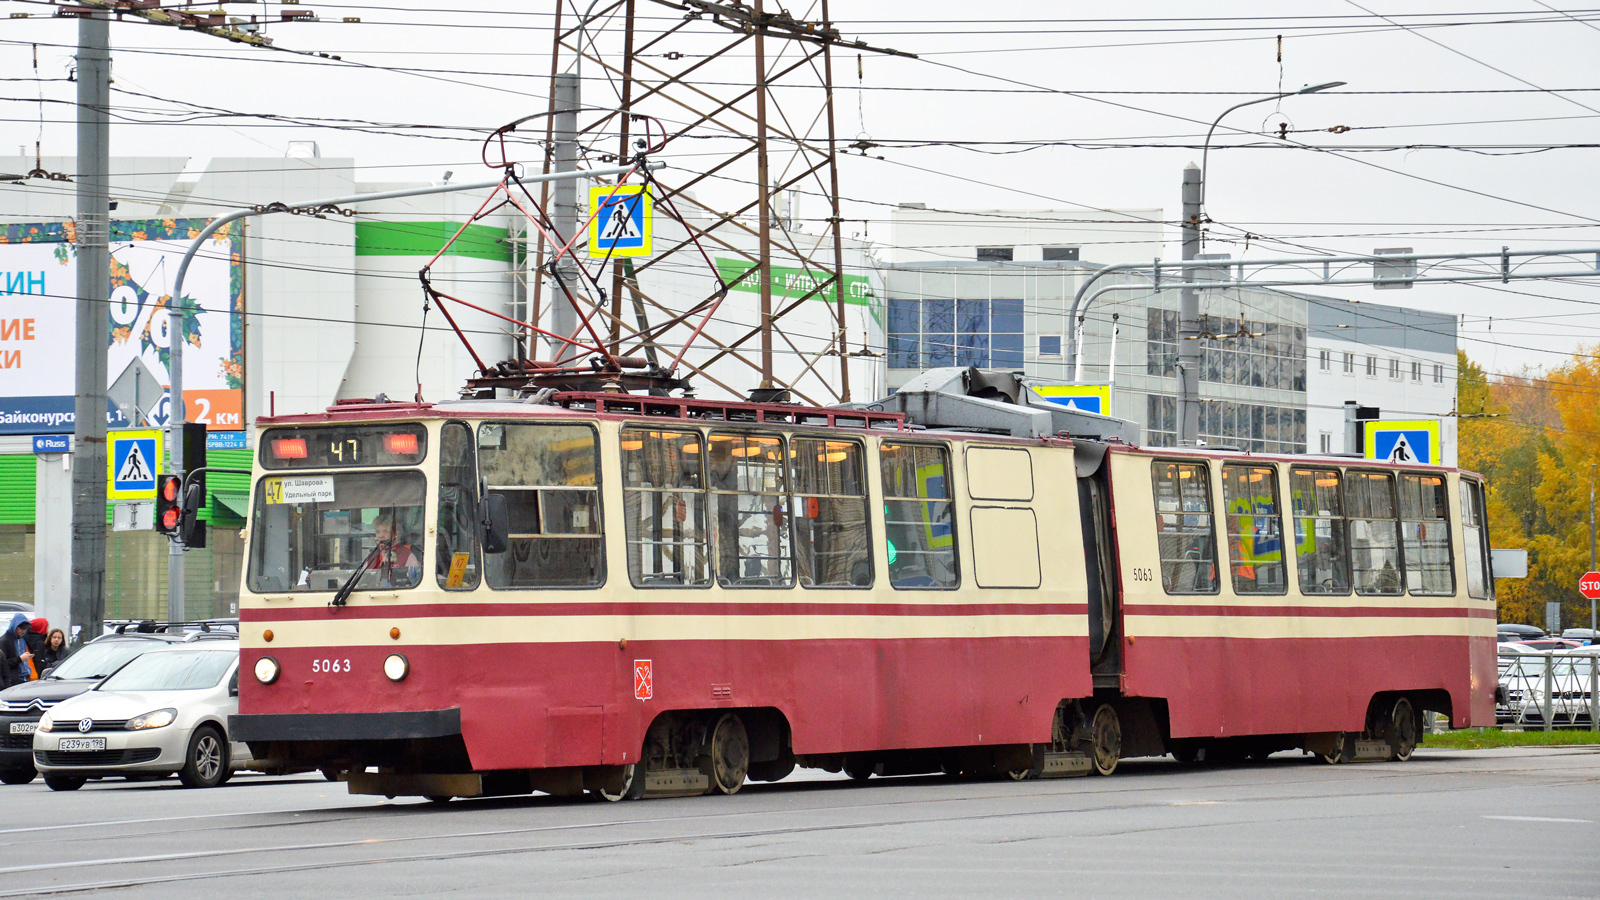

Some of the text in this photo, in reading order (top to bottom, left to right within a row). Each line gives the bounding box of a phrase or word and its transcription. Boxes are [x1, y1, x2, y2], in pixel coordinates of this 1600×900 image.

[194, 398, 211, 425] 2
[45, 439, 66, 448] Russ
[331, 439, 357, 462] 47
[267, 481, 282, 500] 47
[1133, 568, 1153, 582] 5063
[312, 658, 351, 673] 5063
